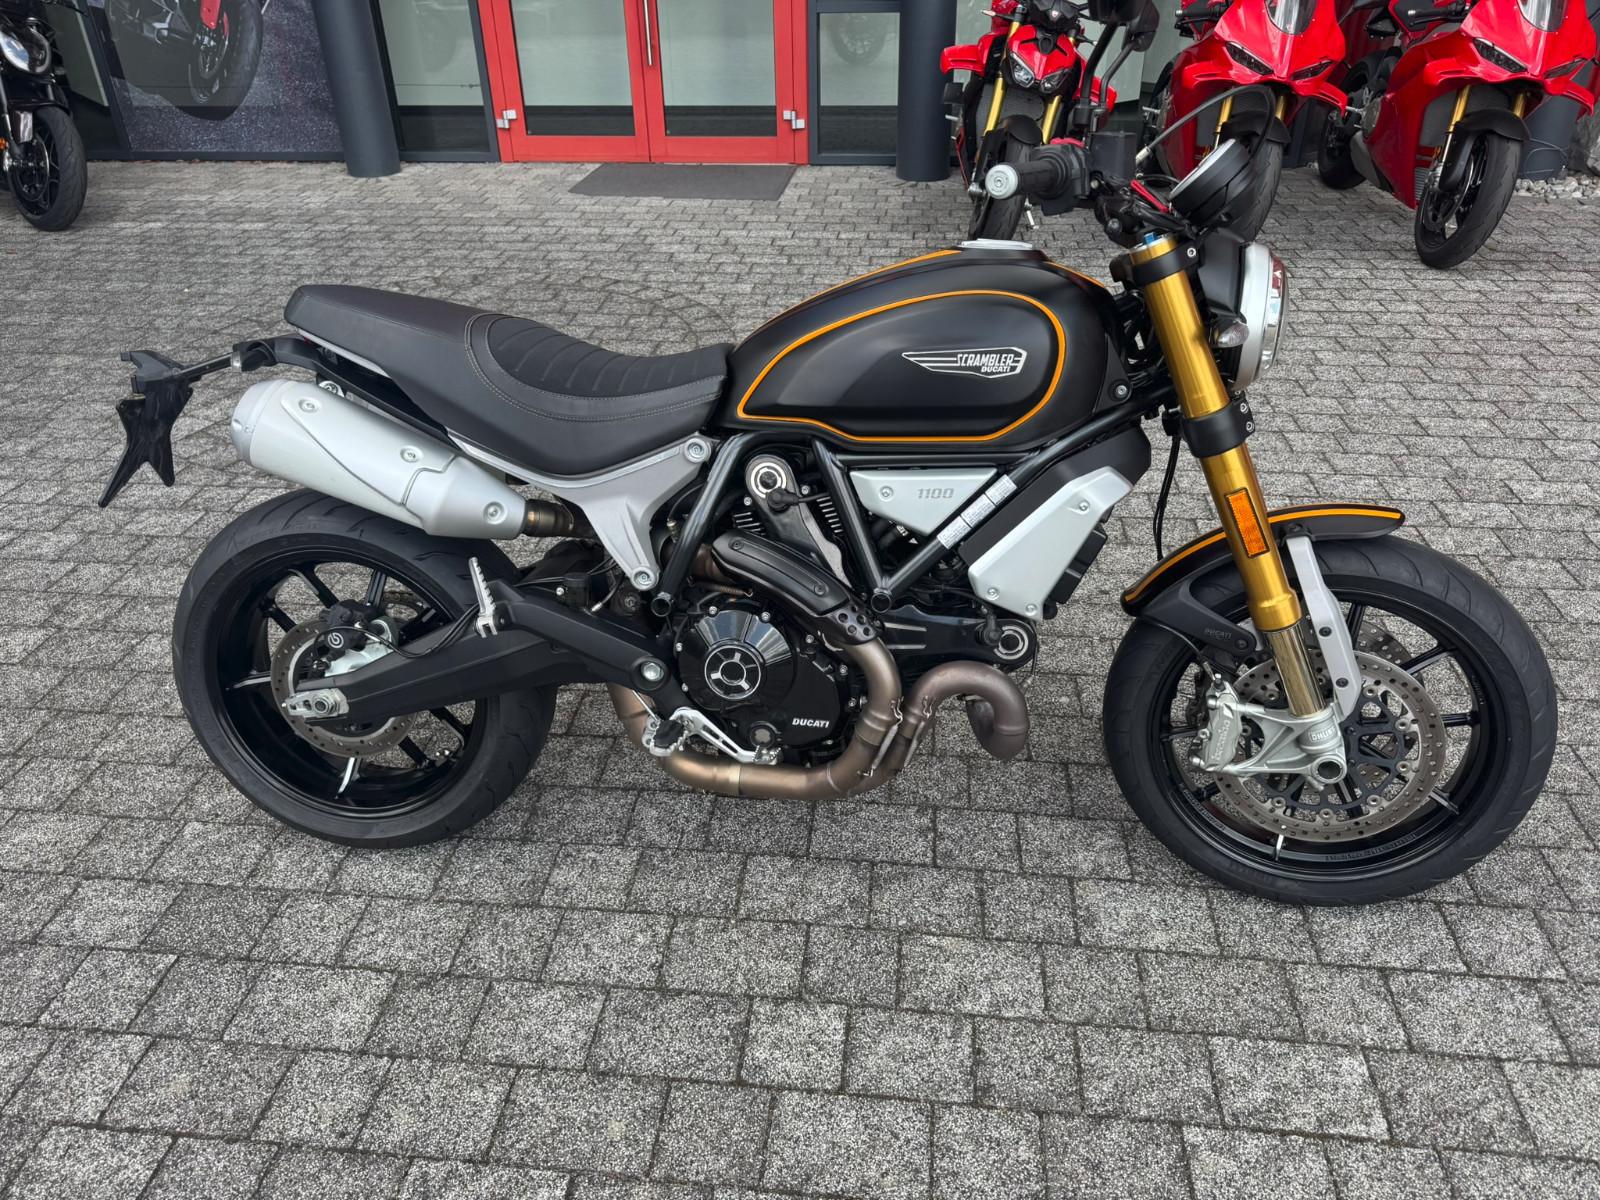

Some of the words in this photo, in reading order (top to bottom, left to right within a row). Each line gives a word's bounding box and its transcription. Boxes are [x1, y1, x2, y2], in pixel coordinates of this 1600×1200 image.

[957, 353, 1014, 367] SCRAMBLER
[917, 488, 954, 499] 1100
[792, 718, 830, 728] DUCATI
